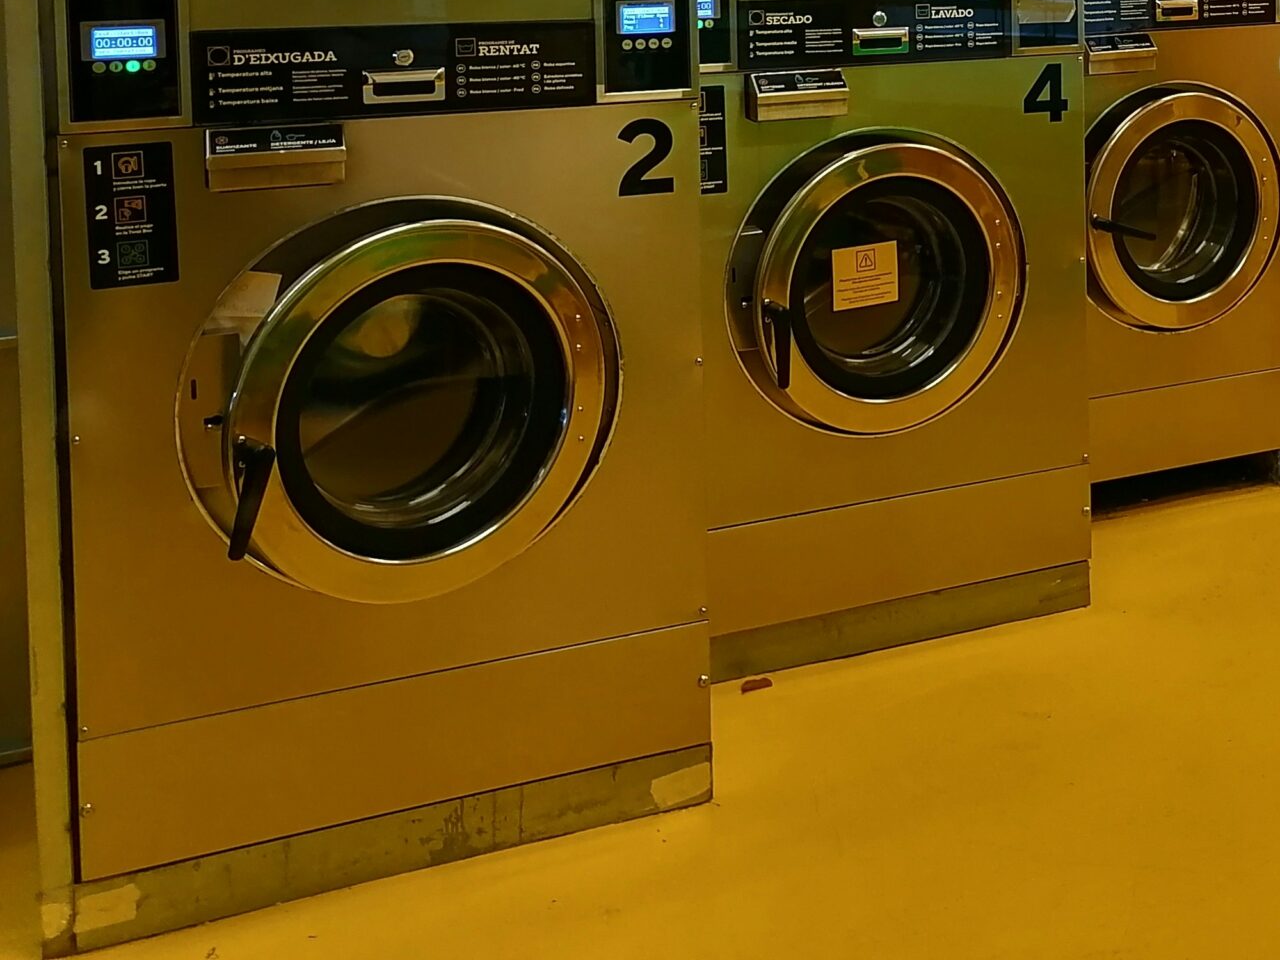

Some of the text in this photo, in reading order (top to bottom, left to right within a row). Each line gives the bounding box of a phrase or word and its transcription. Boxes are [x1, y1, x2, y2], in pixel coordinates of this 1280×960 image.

[765, 14, 813, 25] SECADO
[931, 8, 974, 19] LAVADO
[95, 36, 153, 48] 00:00:00
[478, 43, 540, 56] RENTAT
[233, 50, 338, 65] D'EIXUGADA
[217, 71, 259, 79] Temperatura
[218, 86, 258, 94] Temperatura
[259, 85, 283, 93] mitjana
[1024, 63, 1068, 122] 4
[218, 97, 278, 107] Temperatura baixa
[618, 119, 674, 196] 2
[94, 160, 102, 175] 1
[95, 205, 108, 220] 2
[97, 249, 110, 264] 3
